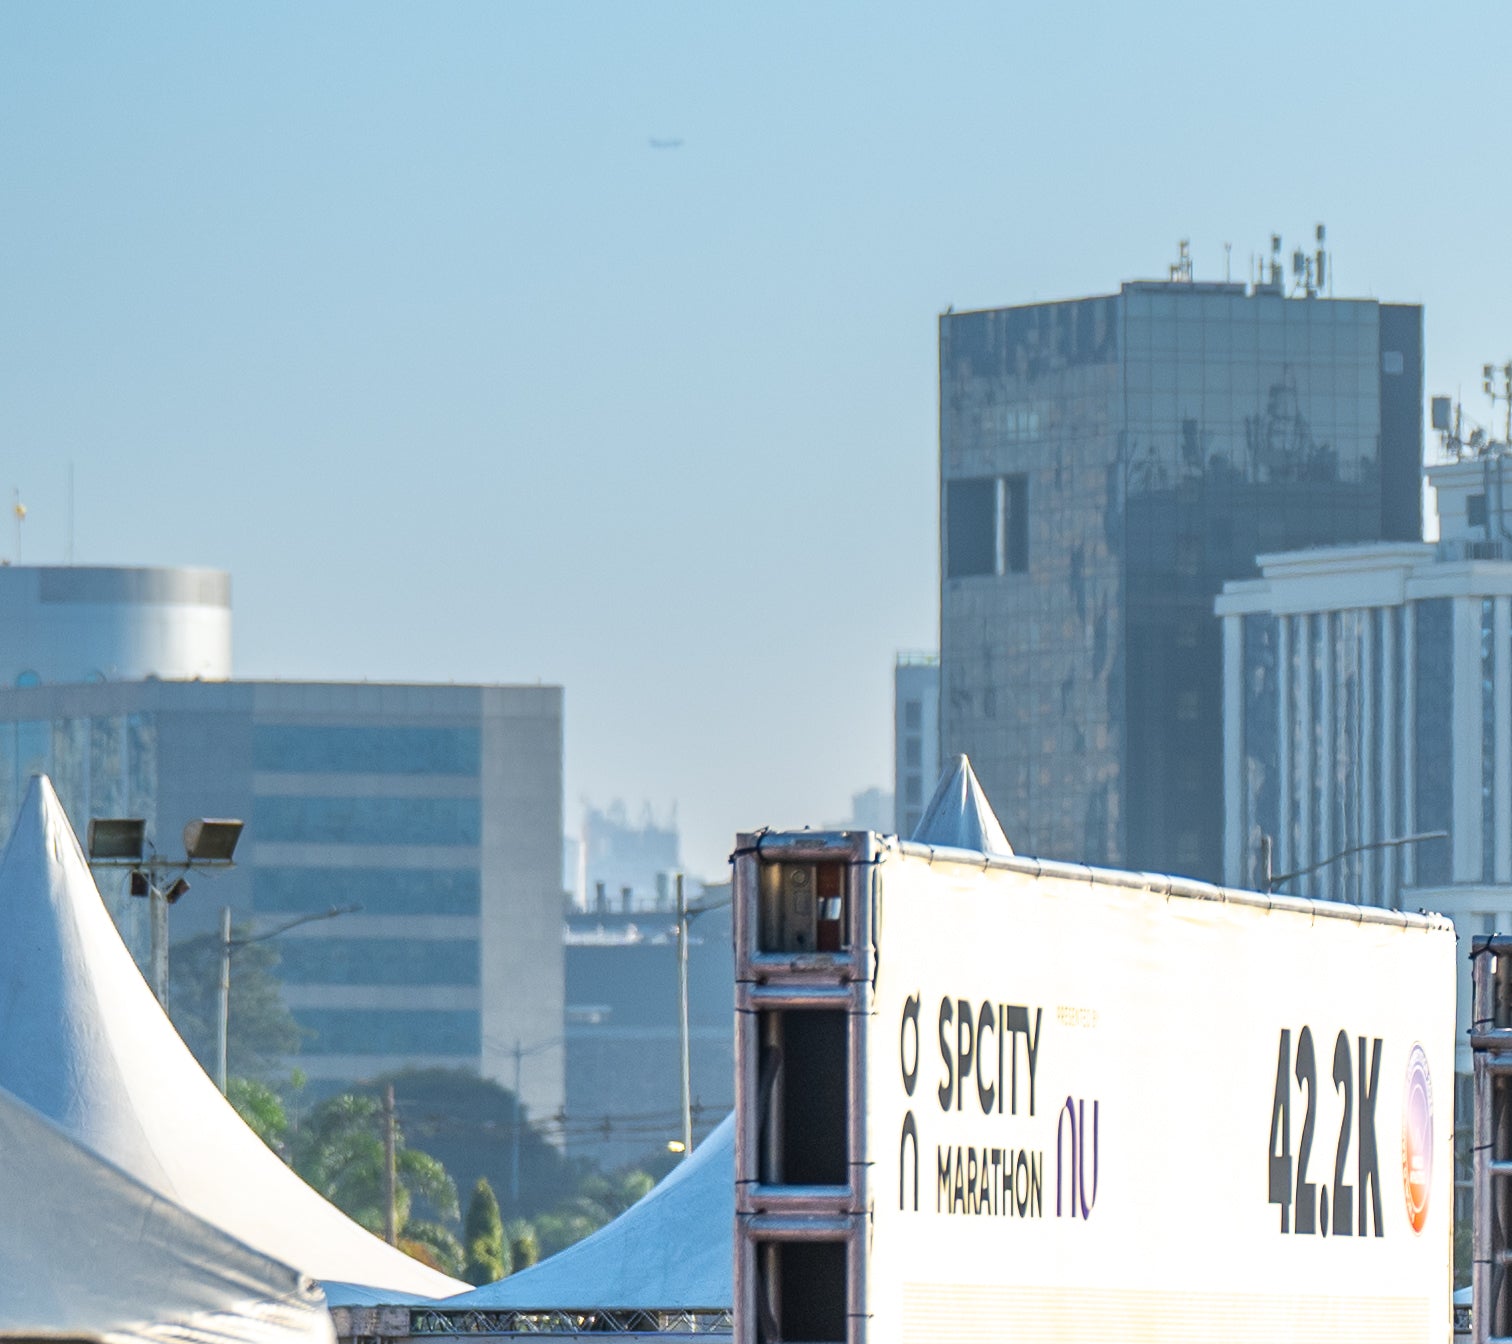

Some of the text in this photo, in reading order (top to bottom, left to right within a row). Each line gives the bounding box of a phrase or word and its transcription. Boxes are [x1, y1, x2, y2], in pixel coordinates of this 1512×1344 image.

[937, 995, 1043, 1117] SPCITY
[937, 1145, 1043, 1219] MARATHON
[1267, 1024, 1385, 1238] 42.2K
